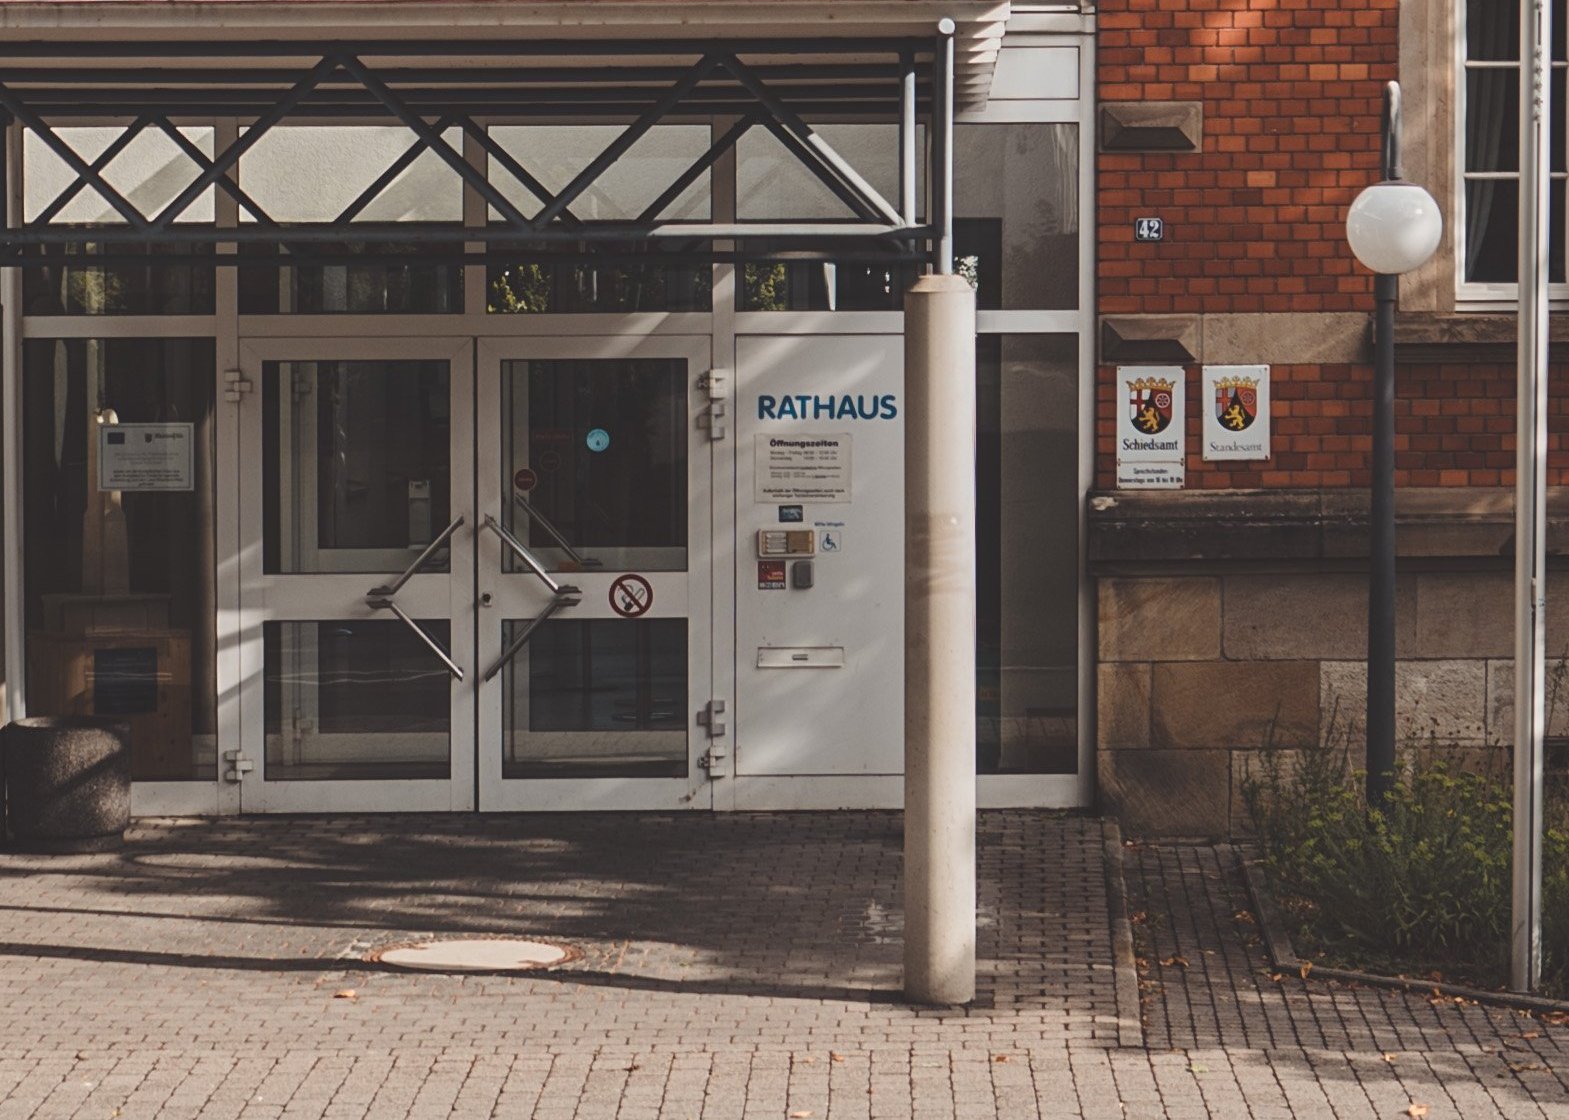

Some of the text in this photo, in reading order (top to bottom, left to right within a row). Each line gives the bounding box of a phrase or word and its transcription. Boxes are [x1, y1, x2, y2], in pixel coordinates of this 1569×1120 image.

[1139, 220, 1159, 238] 42
[758, 395, 897, 420] RATHAUS
[769, 438, 839, 448] Öffnungszeiten
[1122, 438, 1178, 452] Schiedsamt
[1210, 440, 1262, 452] Standesamt
